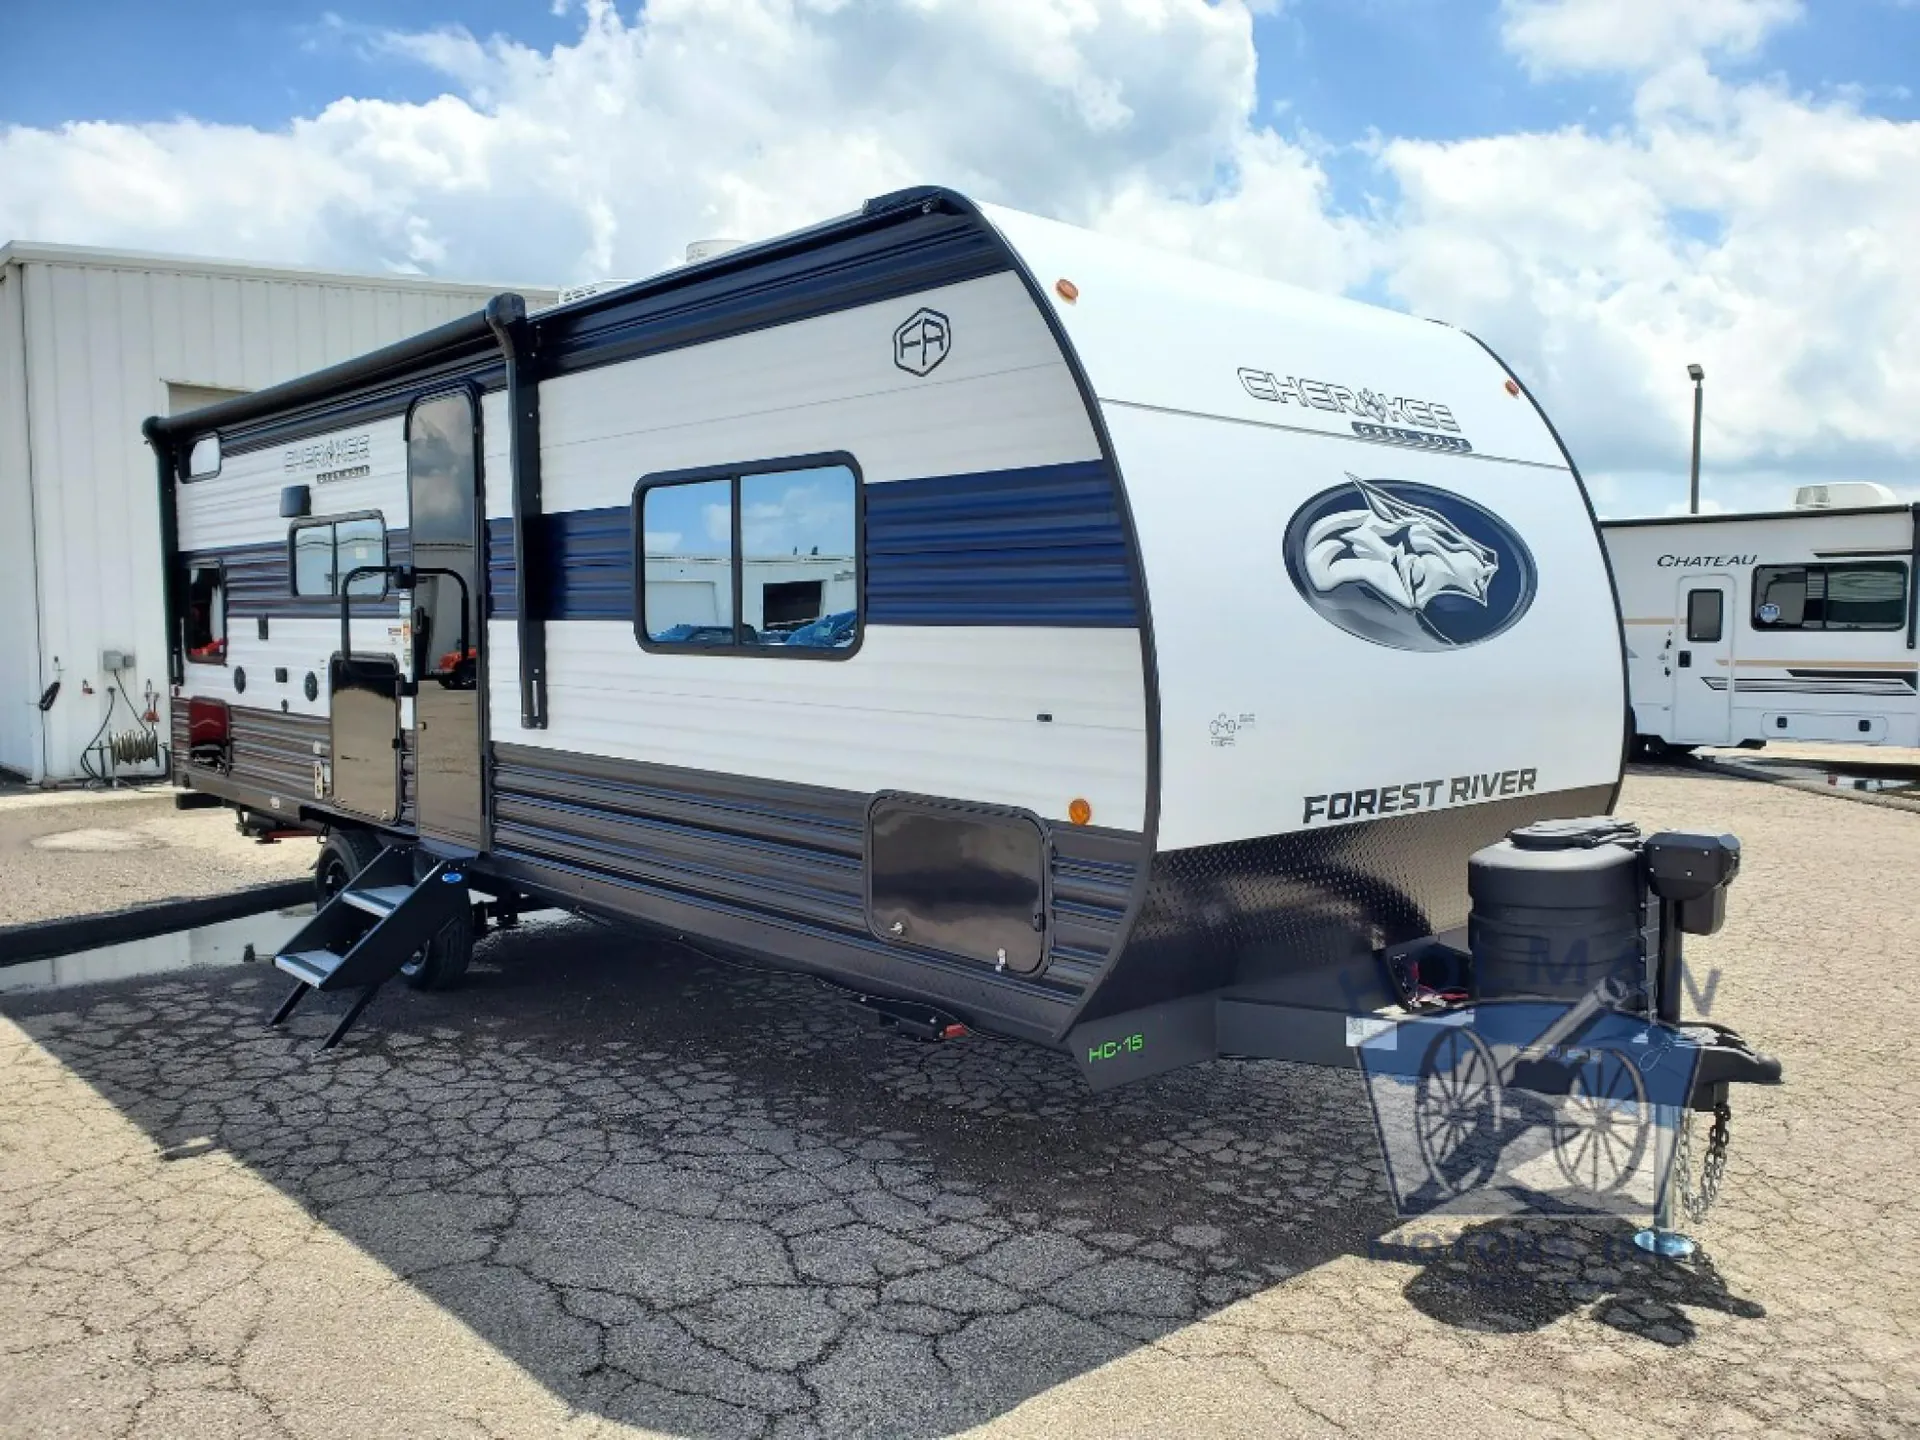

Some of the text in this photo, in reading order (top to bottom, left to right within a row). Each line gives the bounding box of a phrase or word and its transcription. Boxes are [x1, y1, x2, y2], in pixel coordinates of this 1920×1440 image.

[1657, 554, 1758, 568] CHATEAU
[1302, 767, 1538, 824] FOREST RIVER
